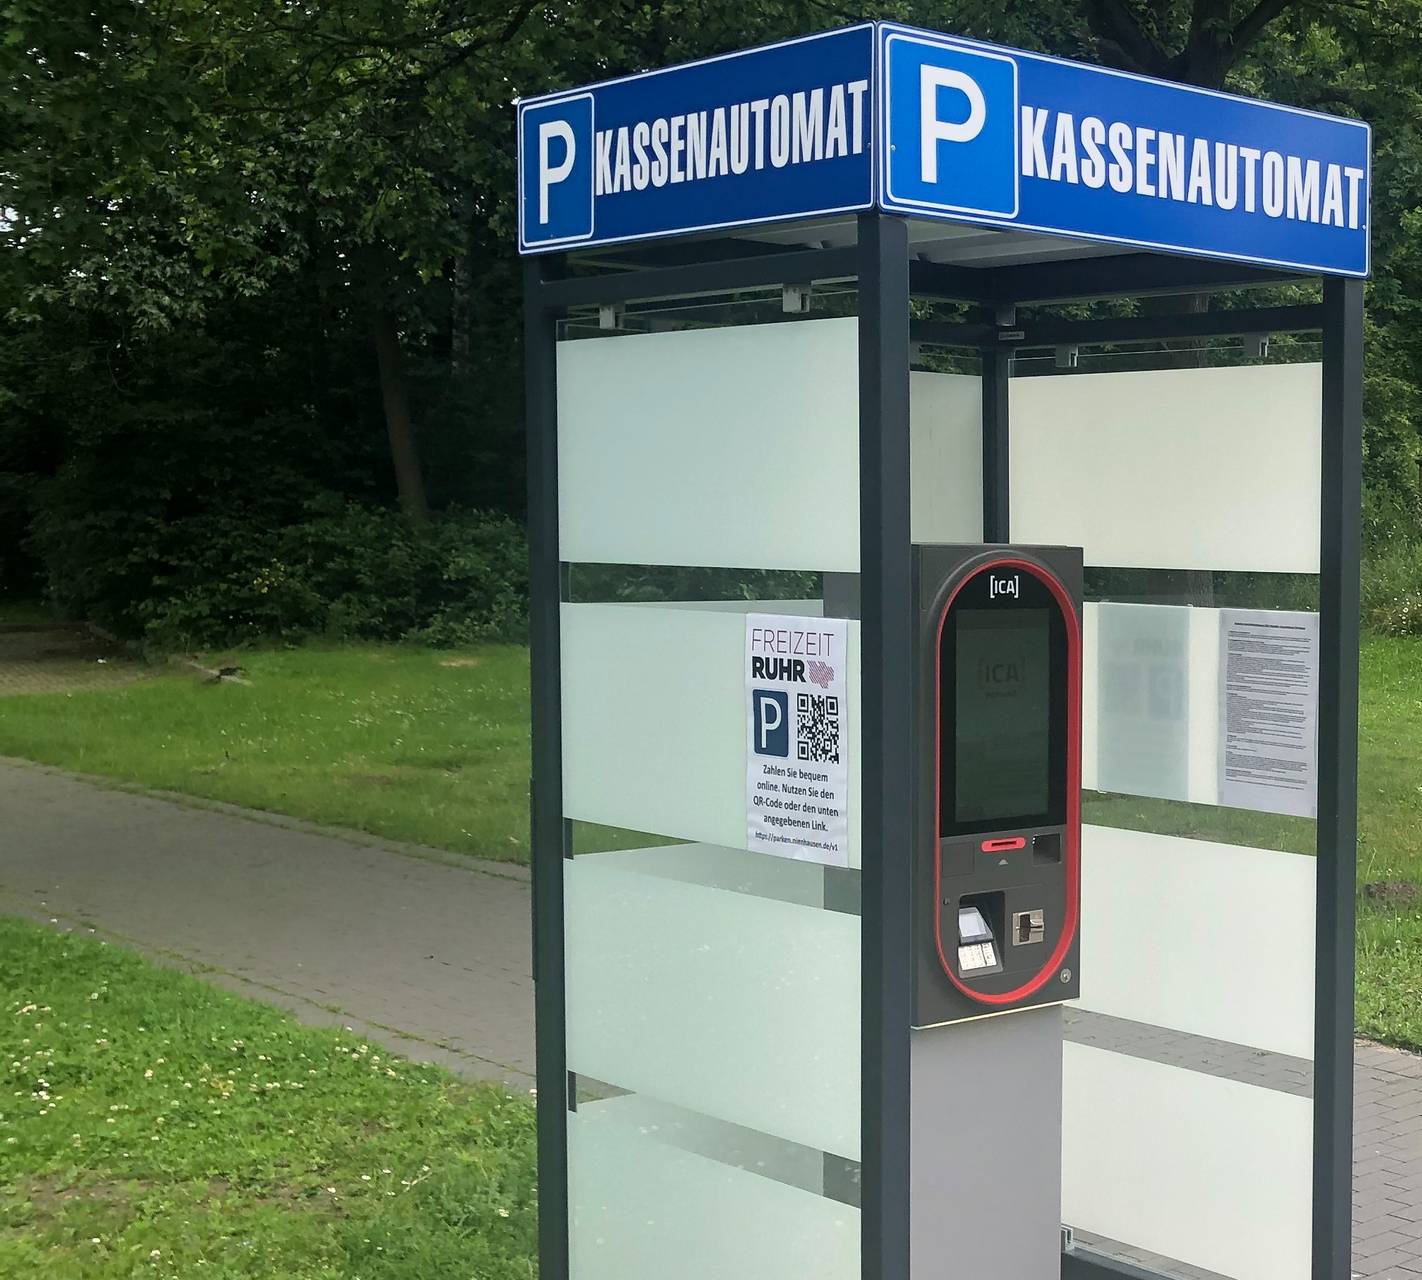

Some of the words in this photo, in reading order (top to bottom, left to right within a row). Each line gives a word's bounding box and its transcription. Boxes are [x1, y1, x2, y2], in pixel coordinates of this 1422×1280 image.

[539, 120, 575, 225] P
[595, 79, 869, 196] KASSENAUTOMAT
[921, 64, 986, 184] P
[1021, 104, 1364, 230] KASSENAUTOMAT
[751, 628, 834, 657] FREIZEIT
[752, 656, 806, 683] RUHR
[760, 697, 782, 748] P
[763, 764, 786, 776] Zahlen
[787, 767, 797, 778] Sie
[799, 769, 828, 782] bequem
[757, 781, 780, 792] online.
[782, 783, 807, 795] Nutzen
[808, 787, 818, 798] Sie
[820, 789, 834, 800] den
[753, 795, 783, 808] QR-Code
[784, 800, 801, 811] oder
[802, 802, 816, 813] den
[817, 806, 839, 817] unten
[763, 815, 810, 827] angegebenen
[811, 820, 828, 832] Link.
